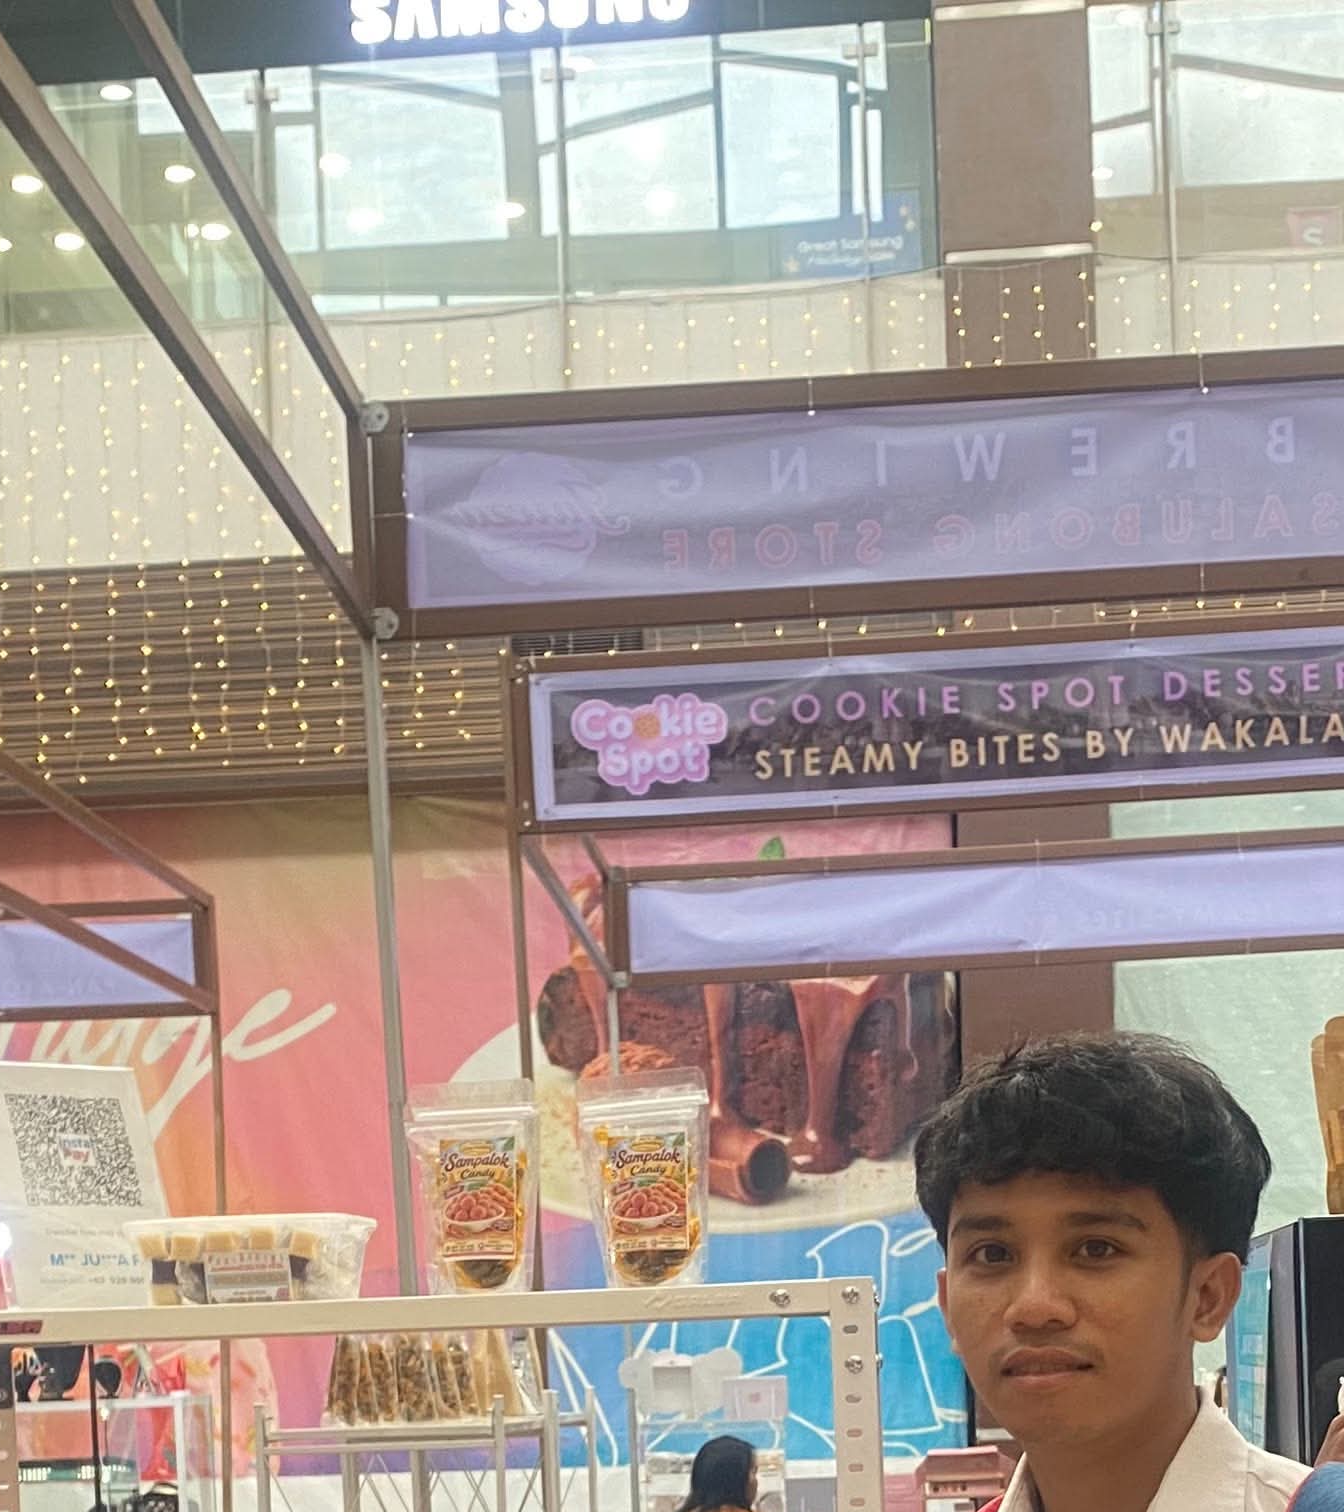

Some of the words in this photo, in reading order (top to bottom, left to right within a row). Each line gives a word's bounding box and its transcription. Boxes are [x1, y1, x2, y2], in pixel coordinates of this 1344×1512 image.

[351, 0, 690, 44] SAMSUNG
[749, 686, 961, 726] COOKIE
[998, 676, 1124, 712] SPOT
[605, 742, 703, 785] Spot
[756, 741, 922, 780] STEAMY
[950, 733, 1060, 768] BITES
[1087, 728, 1133, 759] BY
[444, 1153, 509, 1172] Sampalok
[460, 1169, 496, 1180] Candy
[616, 1149, 680, 1169] Sampalok
[630, 1164, 666, 1176] Candy
